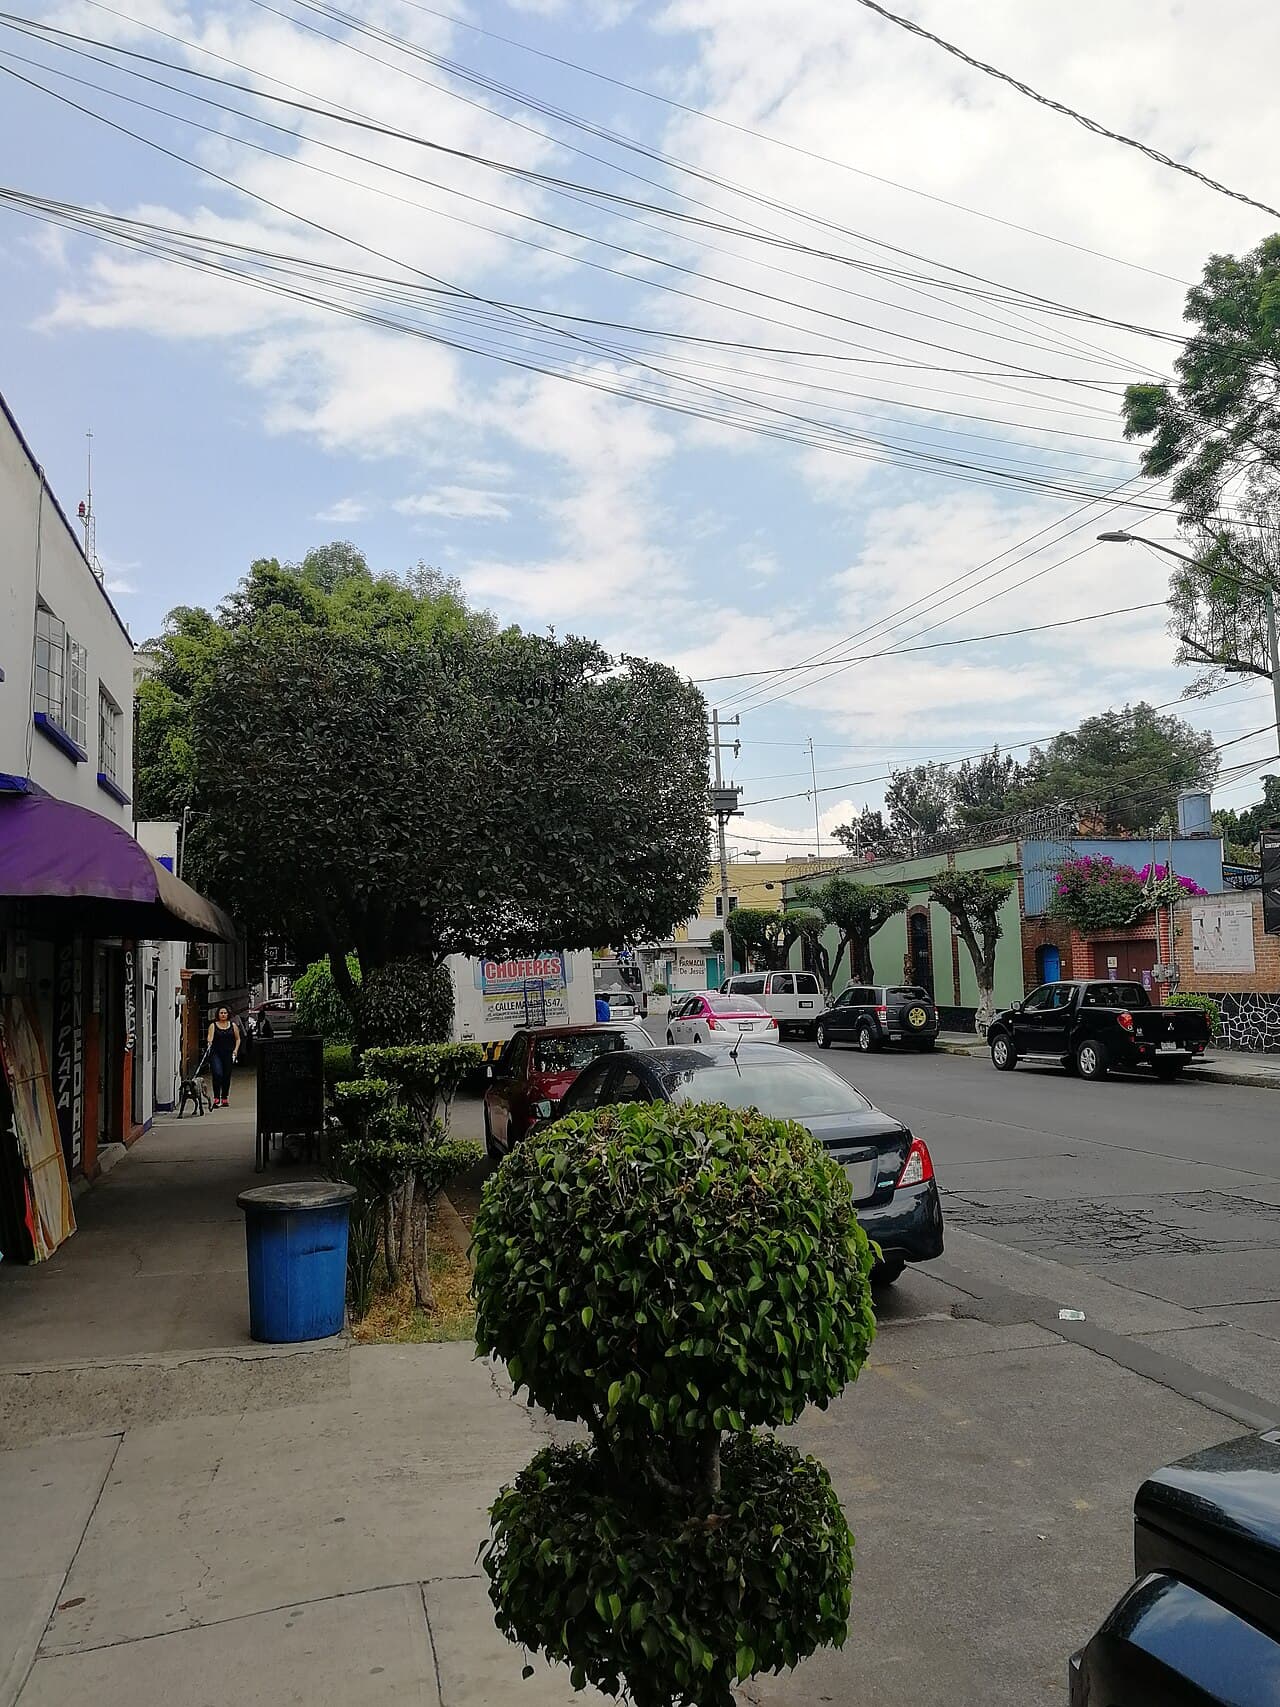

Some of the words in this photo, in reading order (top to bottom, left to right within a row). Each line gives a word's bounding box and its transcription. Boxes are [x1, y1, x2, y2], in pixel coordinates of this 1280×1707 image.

[485, 959, 561, 979] CHOFERES
[495, 1001, 514, 1011] CALLE
[57, 1025, 71, 1109] PLATA
